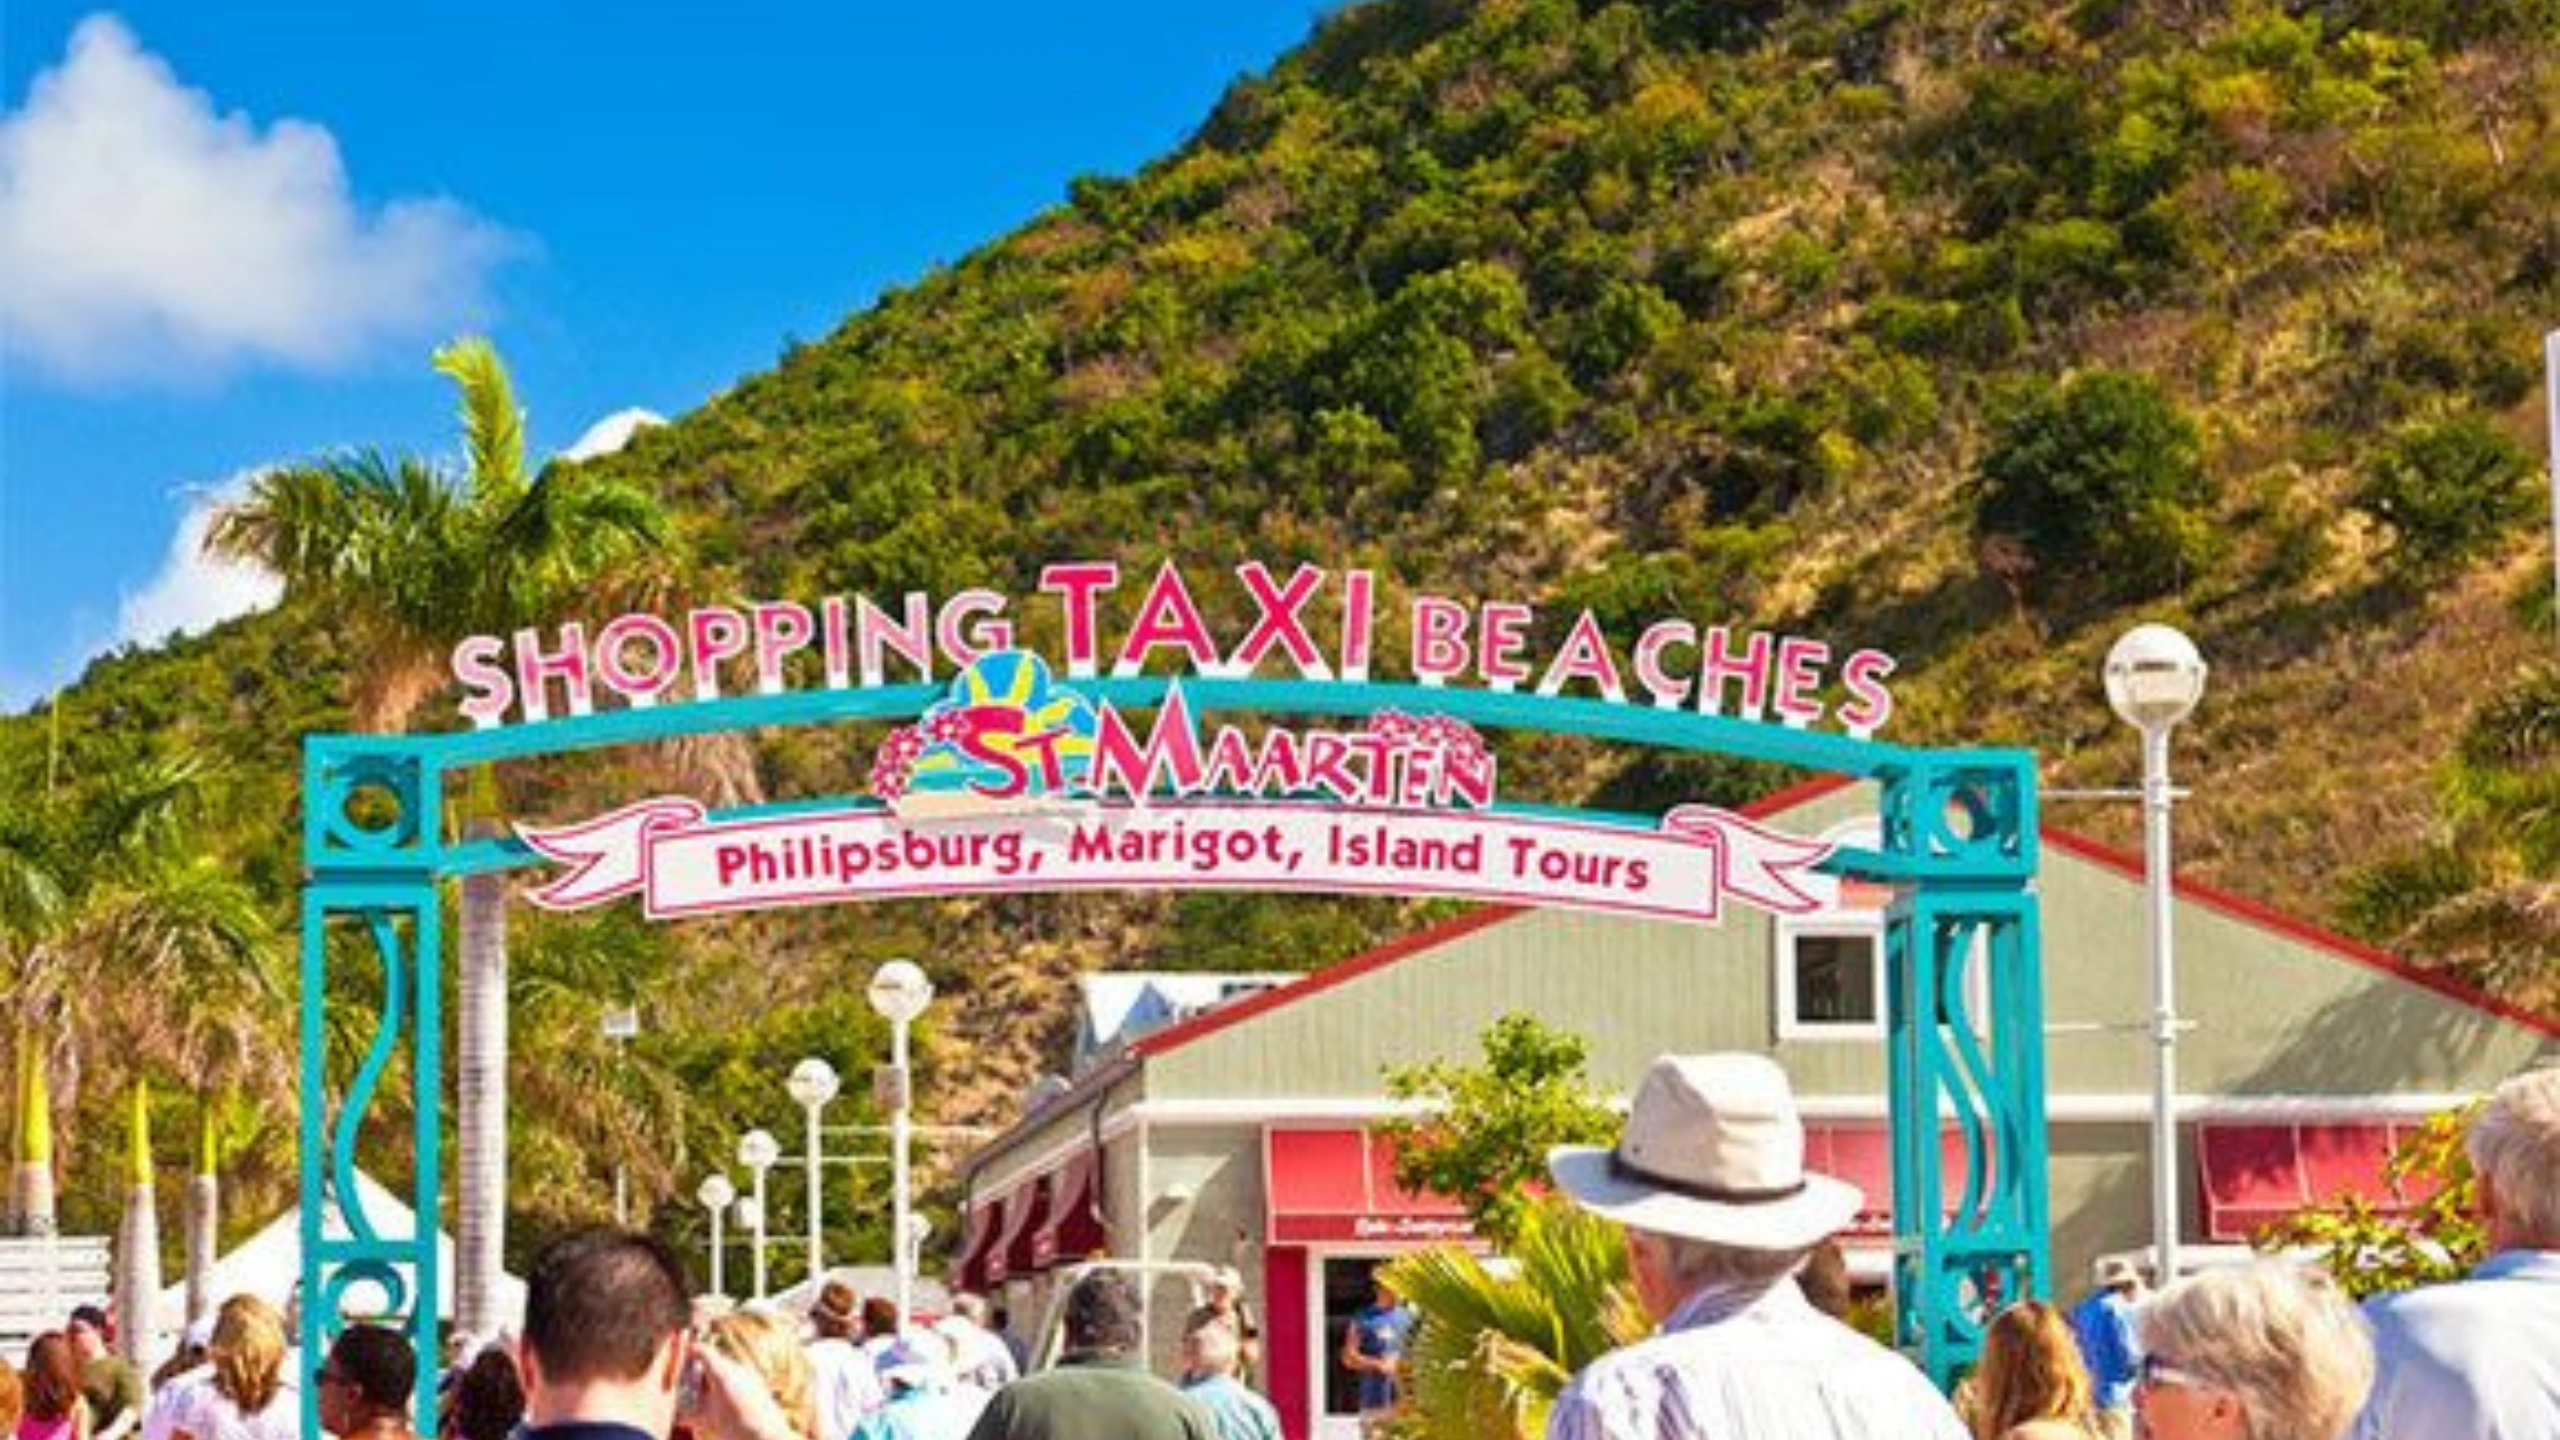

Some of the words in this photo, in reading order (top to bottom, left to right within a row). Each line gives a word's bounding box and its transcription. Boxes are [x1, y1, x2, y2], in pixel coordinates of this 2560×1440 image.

[452, 590, 1010, 726] SHOPPING
[1041, 561, 1373, 680] TAXI
[1413, 598, 1896, 732] BEACHES
[1088, 680, 1496, 808] MAARTEN
[717, 827, 1043, 886] Philipsburg,
[1069, 822, 1303, 872] Marigot,
[1329, 827, 1481, 873] Island
[1509, 841, 1651, 891] Tours
